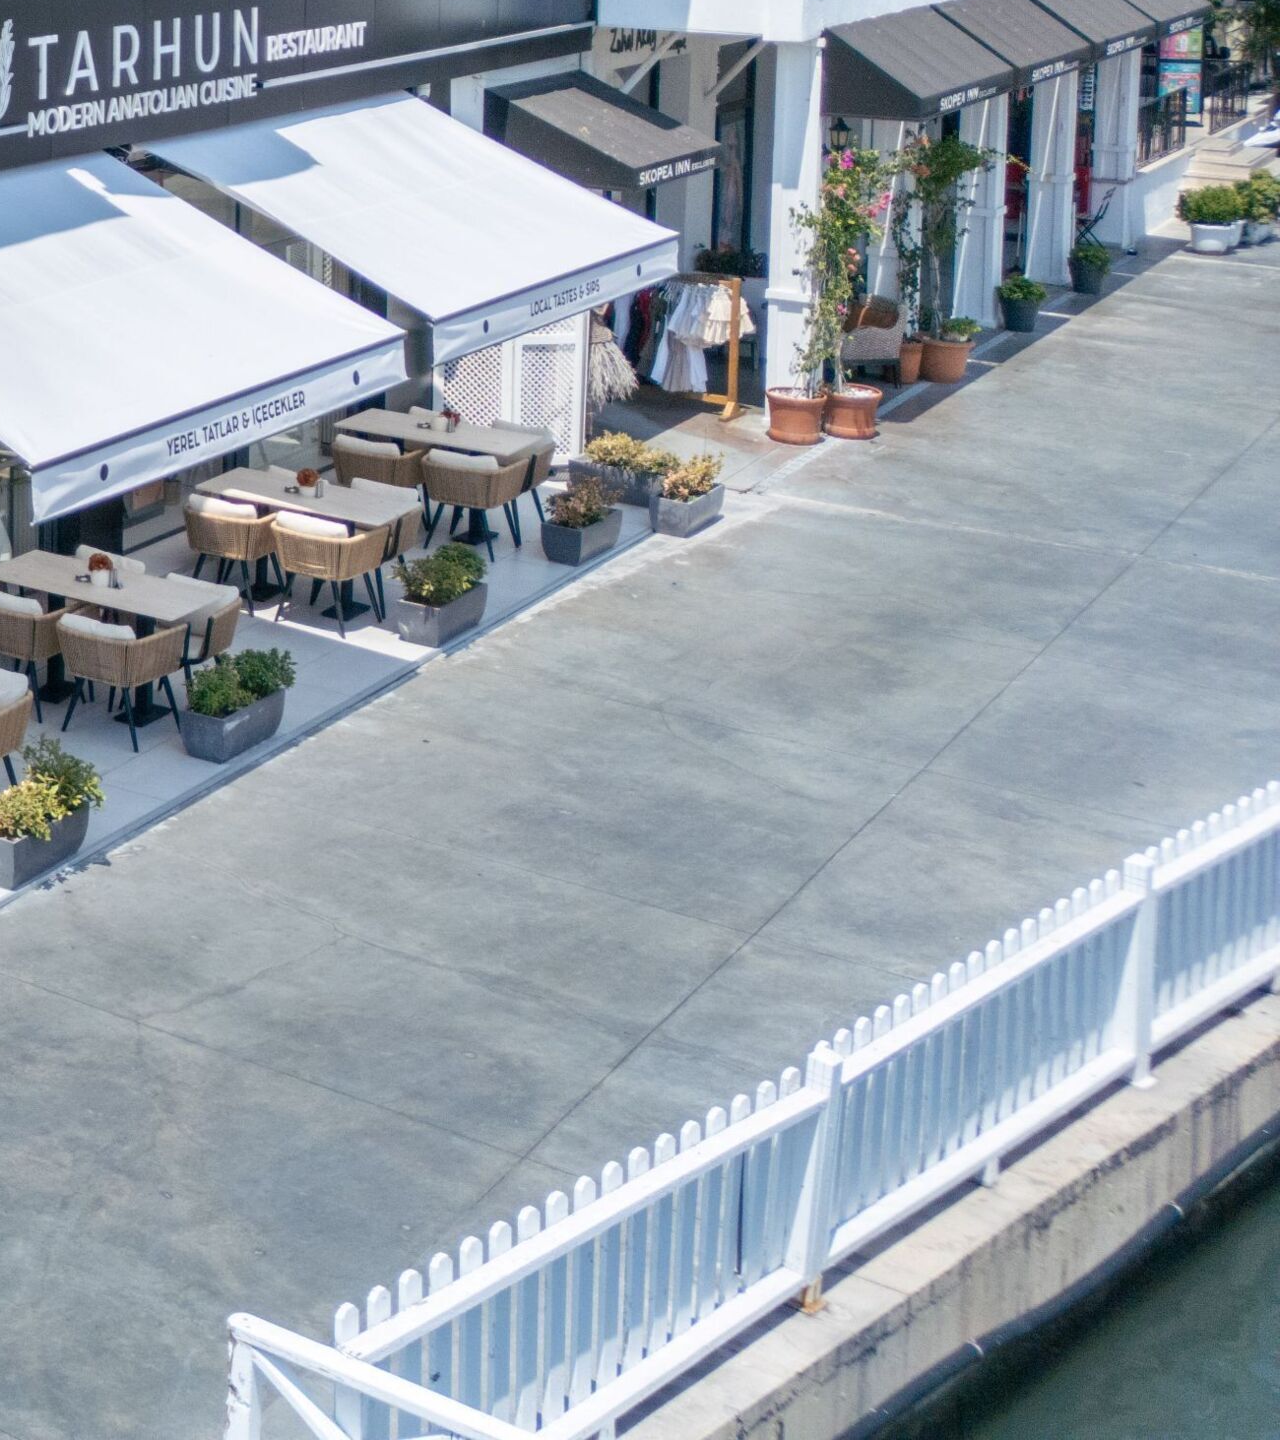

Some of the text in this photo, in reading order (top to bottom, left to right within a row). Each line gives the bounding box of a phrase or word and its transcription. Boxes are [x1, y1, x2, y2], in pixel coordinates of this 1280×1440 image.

[27, 6, 259, 100] TARHUN
[266, 21, 367, 61] RESTAURANT
[27, 73, 259, 138] MODERN ANATOLIAN CUISINE
[639, 163, 674, 186] SKOPEA
[675, 158, 691, 176] INN
[530, 279, 600, 317] LOCAL TASTES & SIPS
[166, 427, 200, 457] YEREL
[202, 415, 240, 444] TATLAR
[242, 412, 250, 429] &
